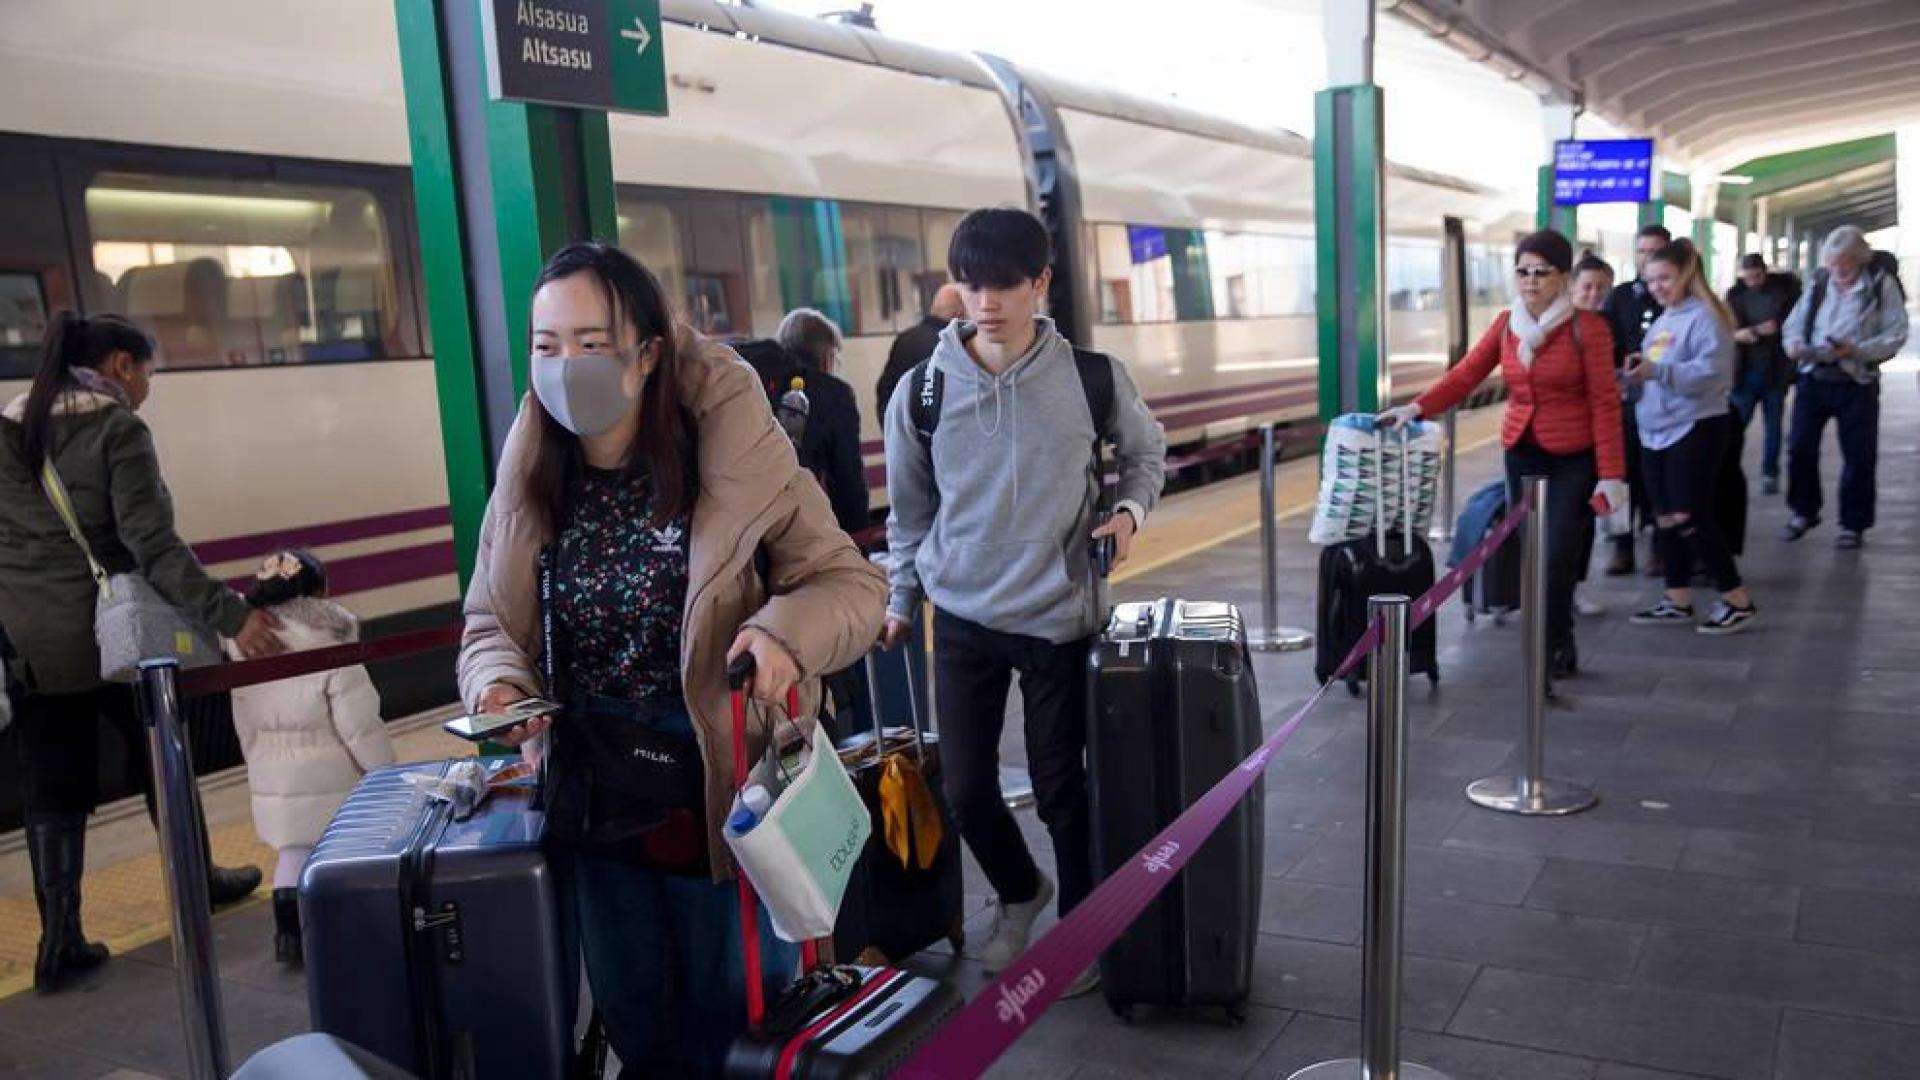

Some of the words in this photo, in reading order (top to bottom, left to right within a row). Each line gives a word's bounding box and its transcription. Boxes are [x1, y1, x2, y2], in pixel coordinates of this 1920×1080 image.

[517, 0, 589, 34] Alsasua
[522, 36, 593, 71] Altsasu
[995, 967, 1046, 1024] renfe
